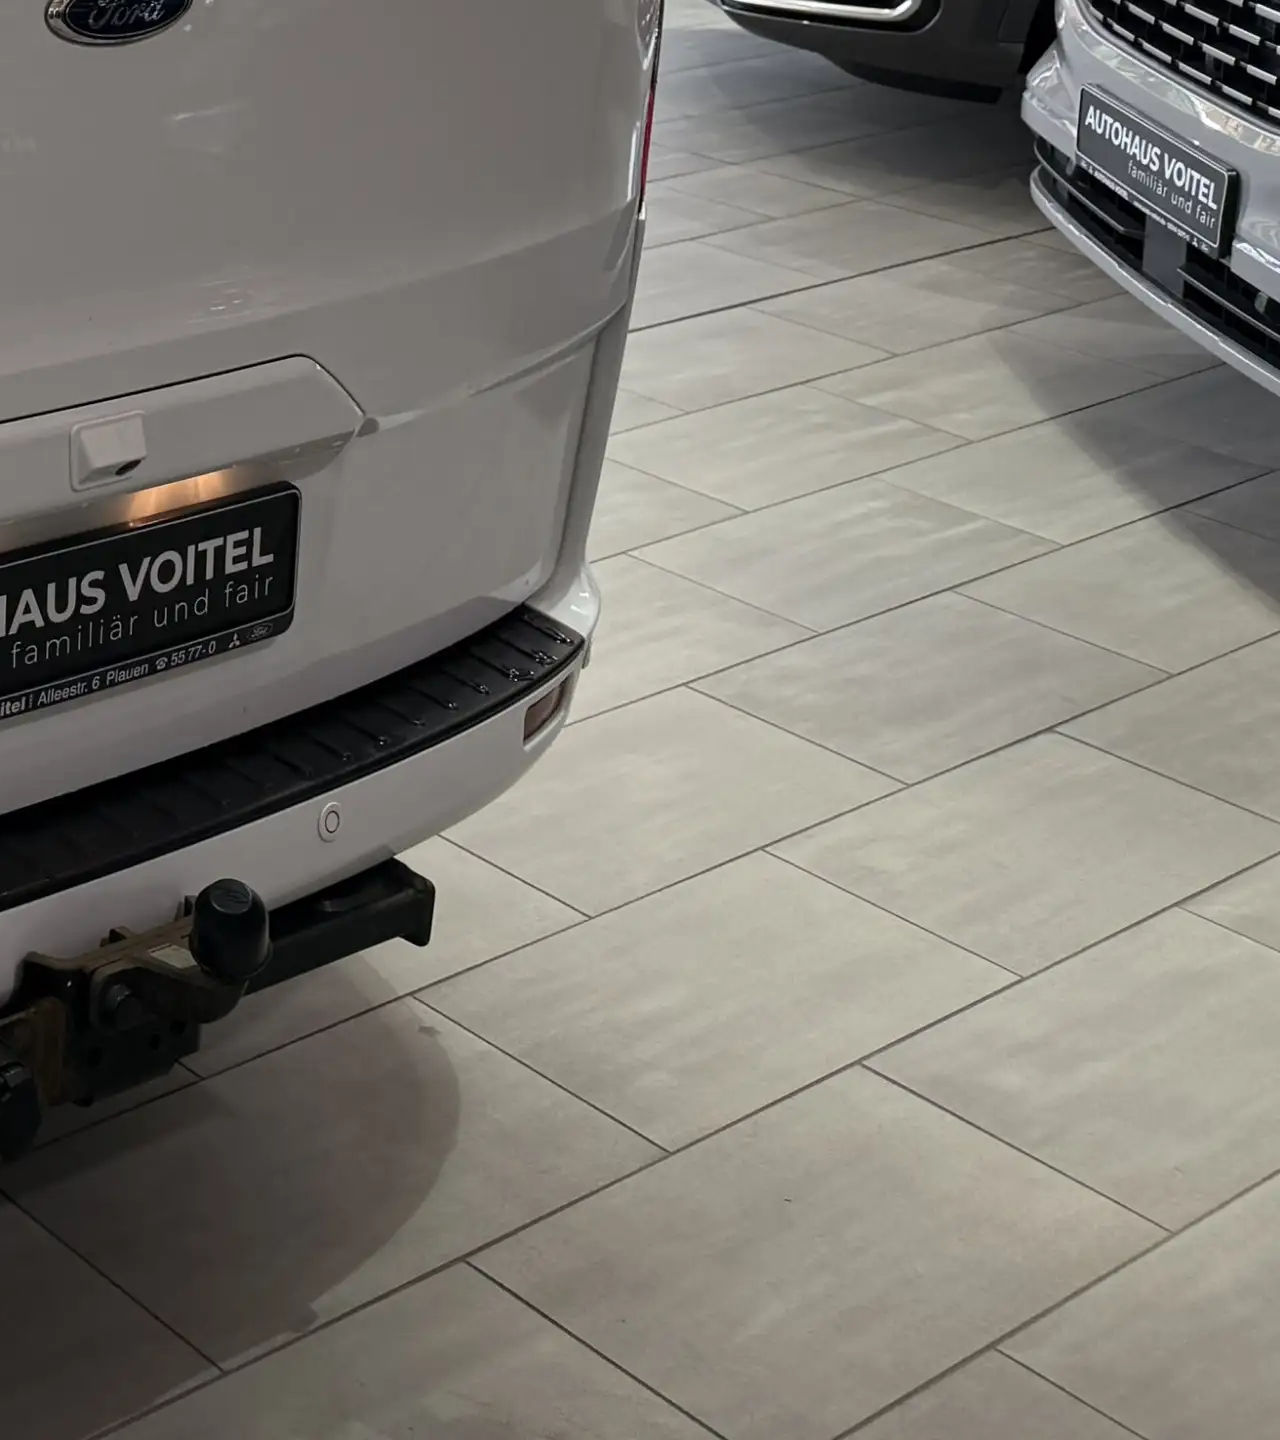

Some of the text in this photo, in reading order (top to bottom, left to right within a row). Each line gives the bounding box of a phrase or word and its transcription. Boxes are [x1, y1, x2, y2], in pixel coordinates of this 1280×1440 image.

[1085, 105, 1161, 172] AUTOHAUS
[1164, 152, 1218, 210] VOITEL
[1128, 160, 1216, 229] familiär und fair
[117, 527, 274, 602] VOITEL
[11, 572, 274, 669] familiär und fair
[37, 681, 88, 707] Alleestr.
[92, 676, 100, 690] 6
[106, 663, 149, 686] Plauen
